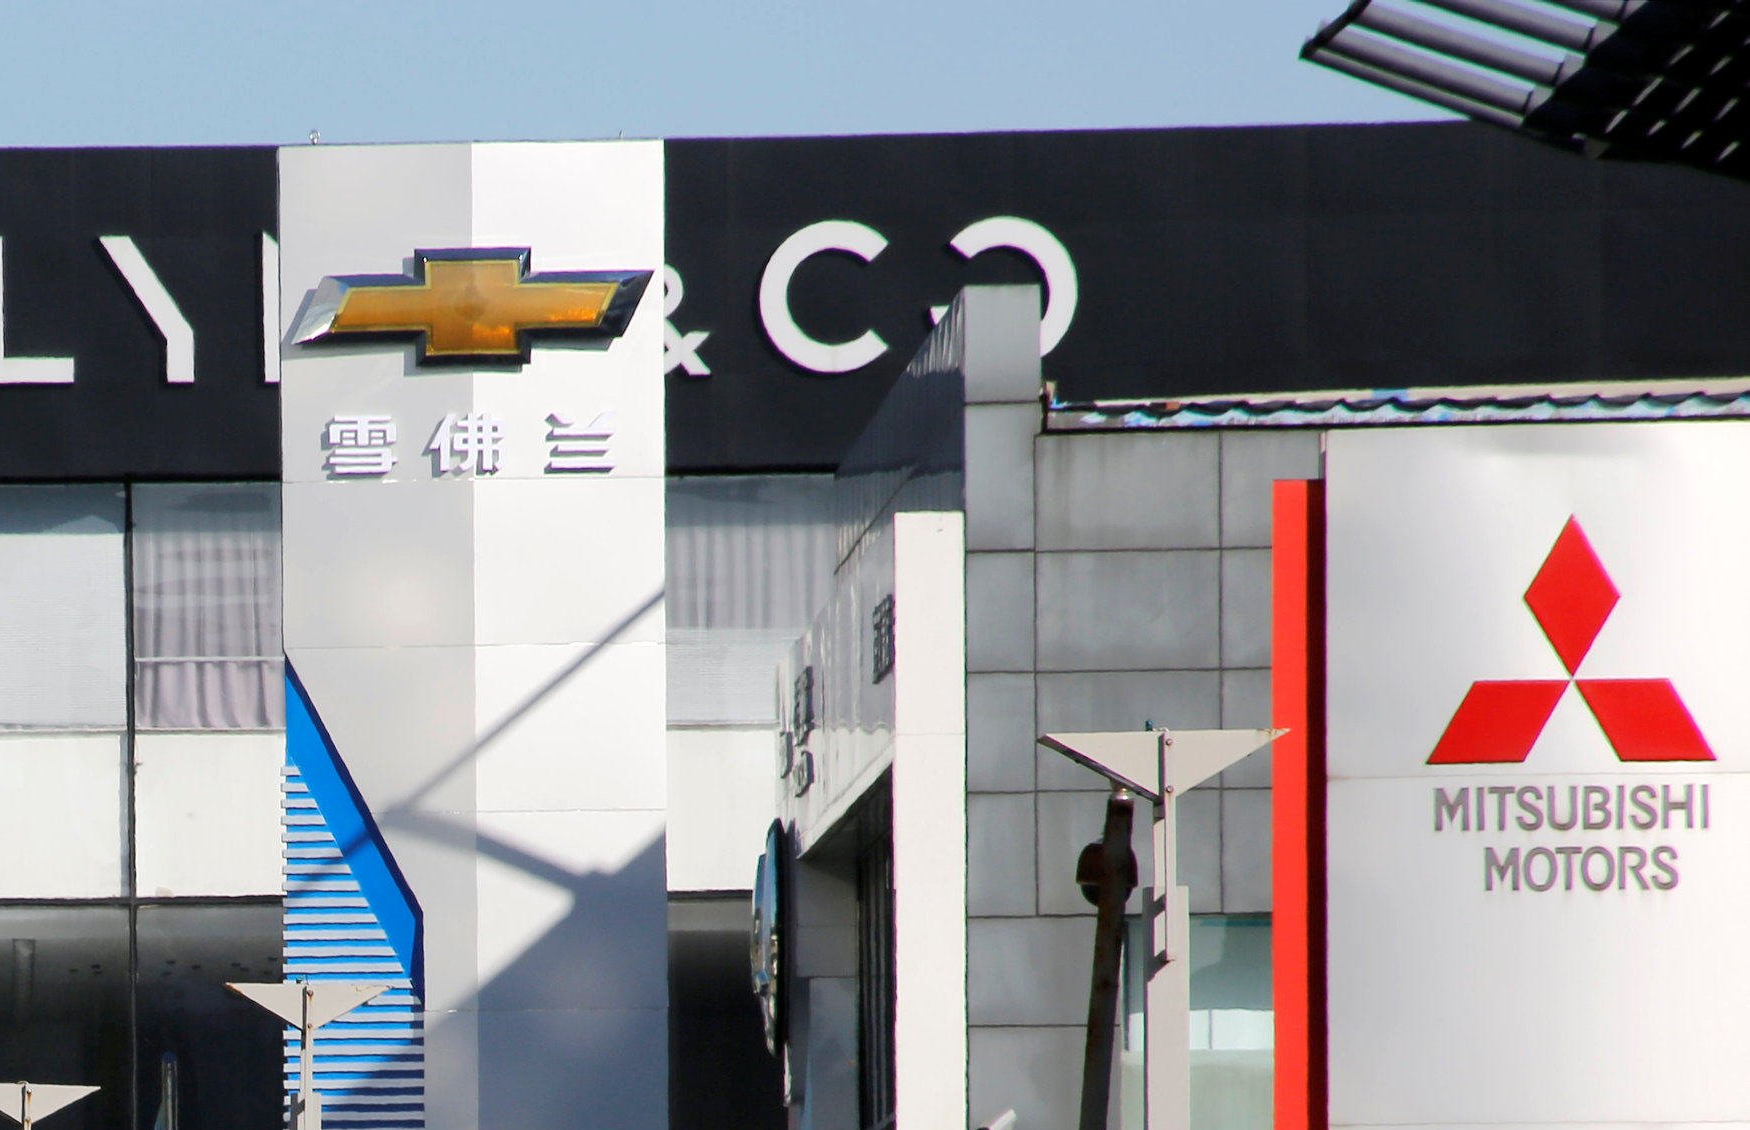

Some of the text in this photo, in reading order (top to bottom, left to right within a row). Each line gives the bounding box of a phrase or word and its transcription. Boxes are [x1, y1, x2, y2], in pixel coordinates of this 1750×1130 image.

[328, 411, 616, 473] 雪佛兰
[1434, 785, 1710, 832] MITSUBISHI
[1484, 846, 1679, 892] MOTORS
